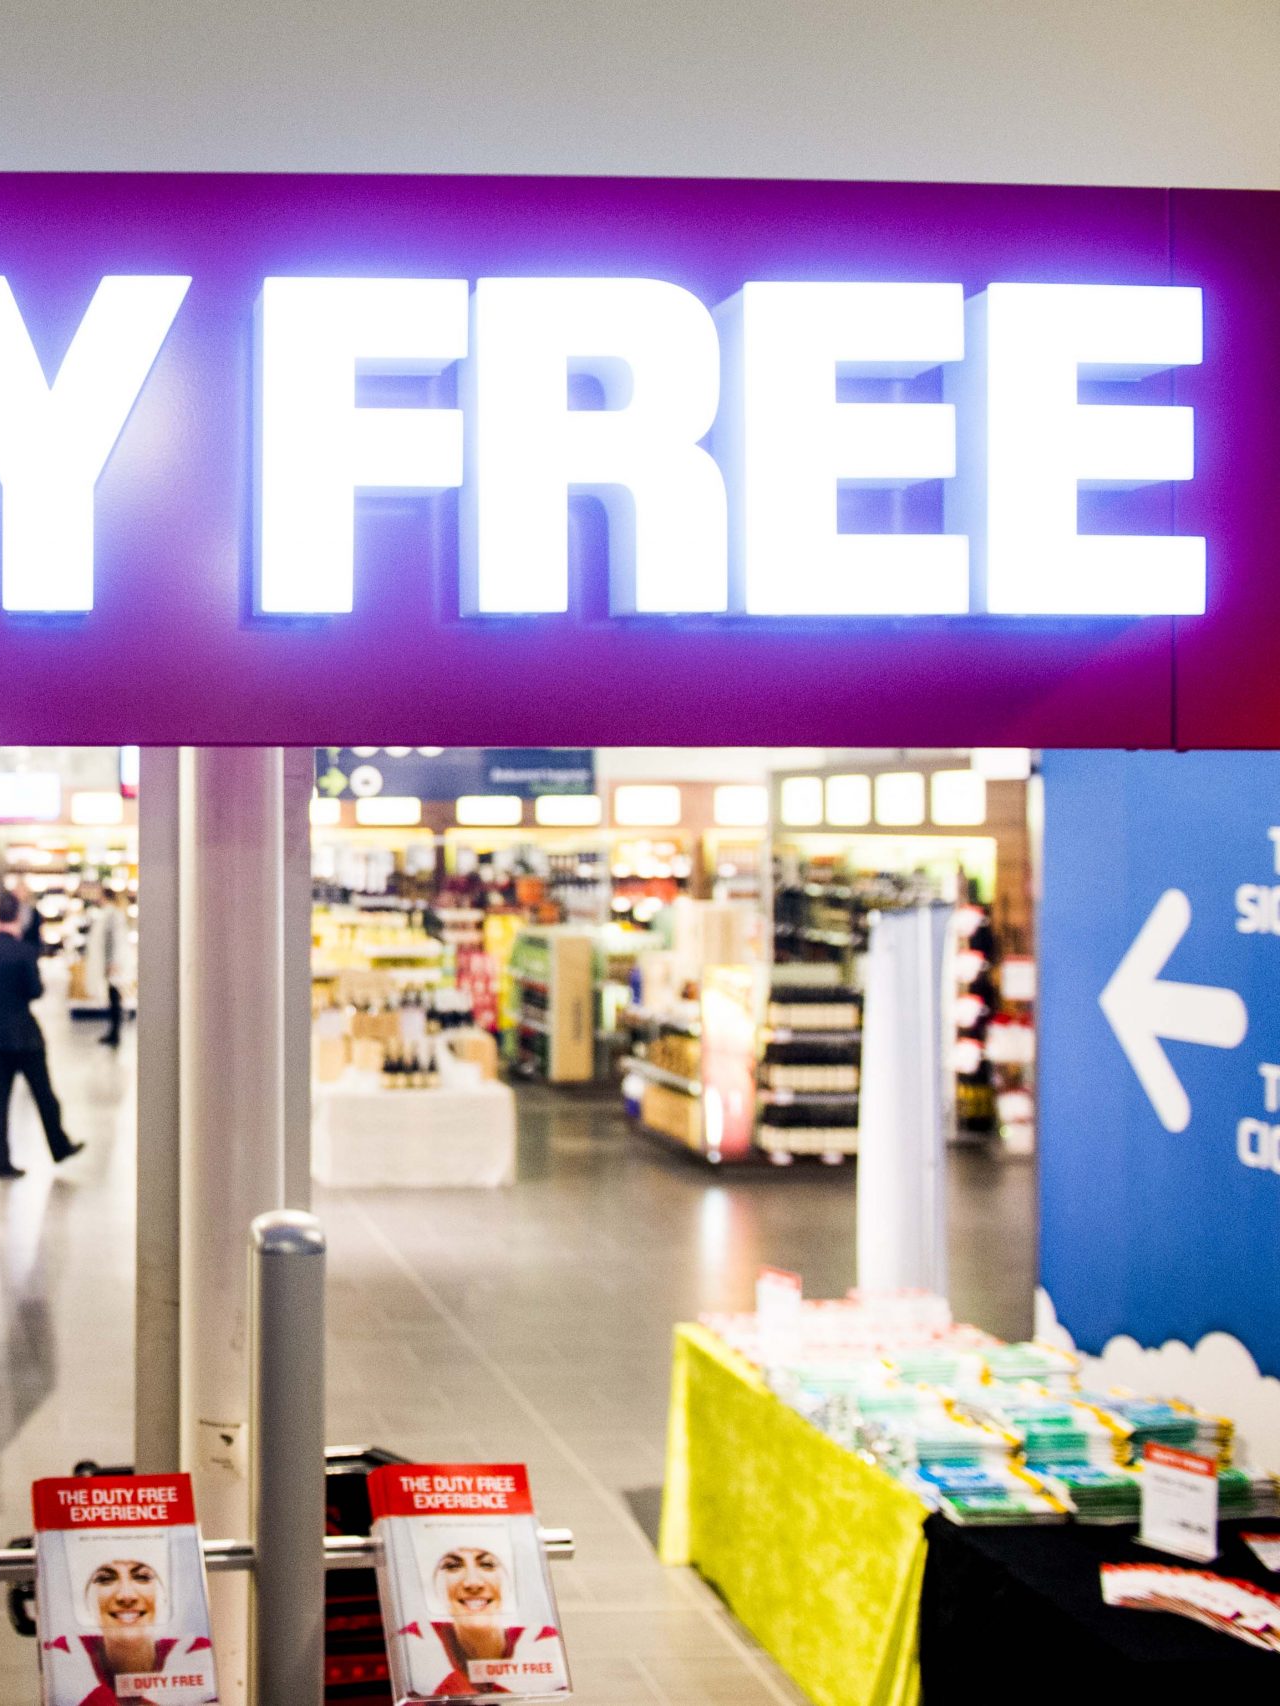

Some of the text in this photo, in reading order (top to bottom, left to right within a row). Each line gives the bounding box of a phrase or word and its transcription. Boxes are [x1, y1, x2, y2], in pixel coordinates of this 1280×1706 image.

[261, 275, 1208, 616] FREE
[399, 1475, 516, 1492] THE DUTY FREE
[57, 1486, 178, 1506] THE DUTY FREE
[414, 1492, 509, 1509] EXPERIENCE
[70, 1504, 169, 1523] EXPERIENCE
[486, 1663, 518, 1676] DUTY
[522, 1662, 553, 1674] FREE
[133, 1676, 168, 1690] DUTY
[171, 1674, 205, 1688] FREE
